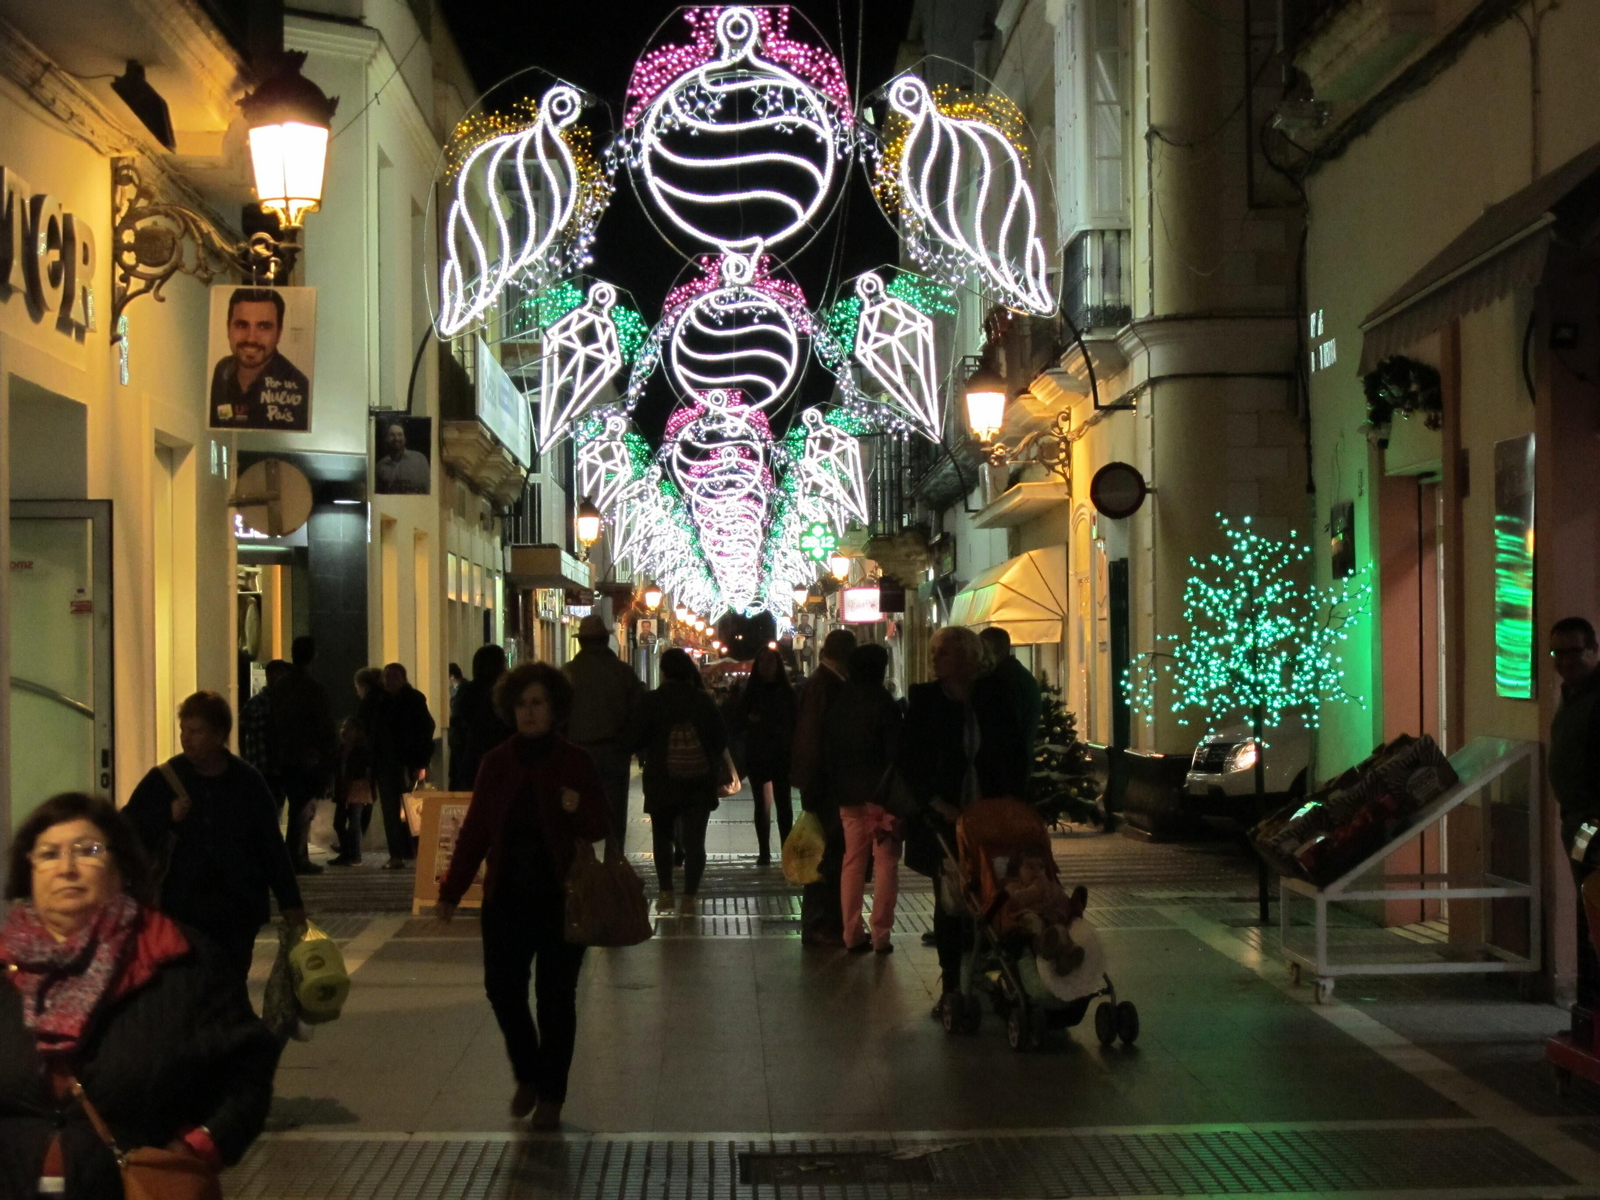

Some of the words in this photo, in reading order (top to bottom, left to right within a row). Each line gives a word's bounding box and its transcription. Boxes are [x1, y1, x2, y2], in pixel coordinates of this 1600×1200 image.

[265, 377, 281, 389] Por
[284, 380, 298, 389] un
[261, 389, 302, 406] Nuevo
[266, 405, 294, 422] País
